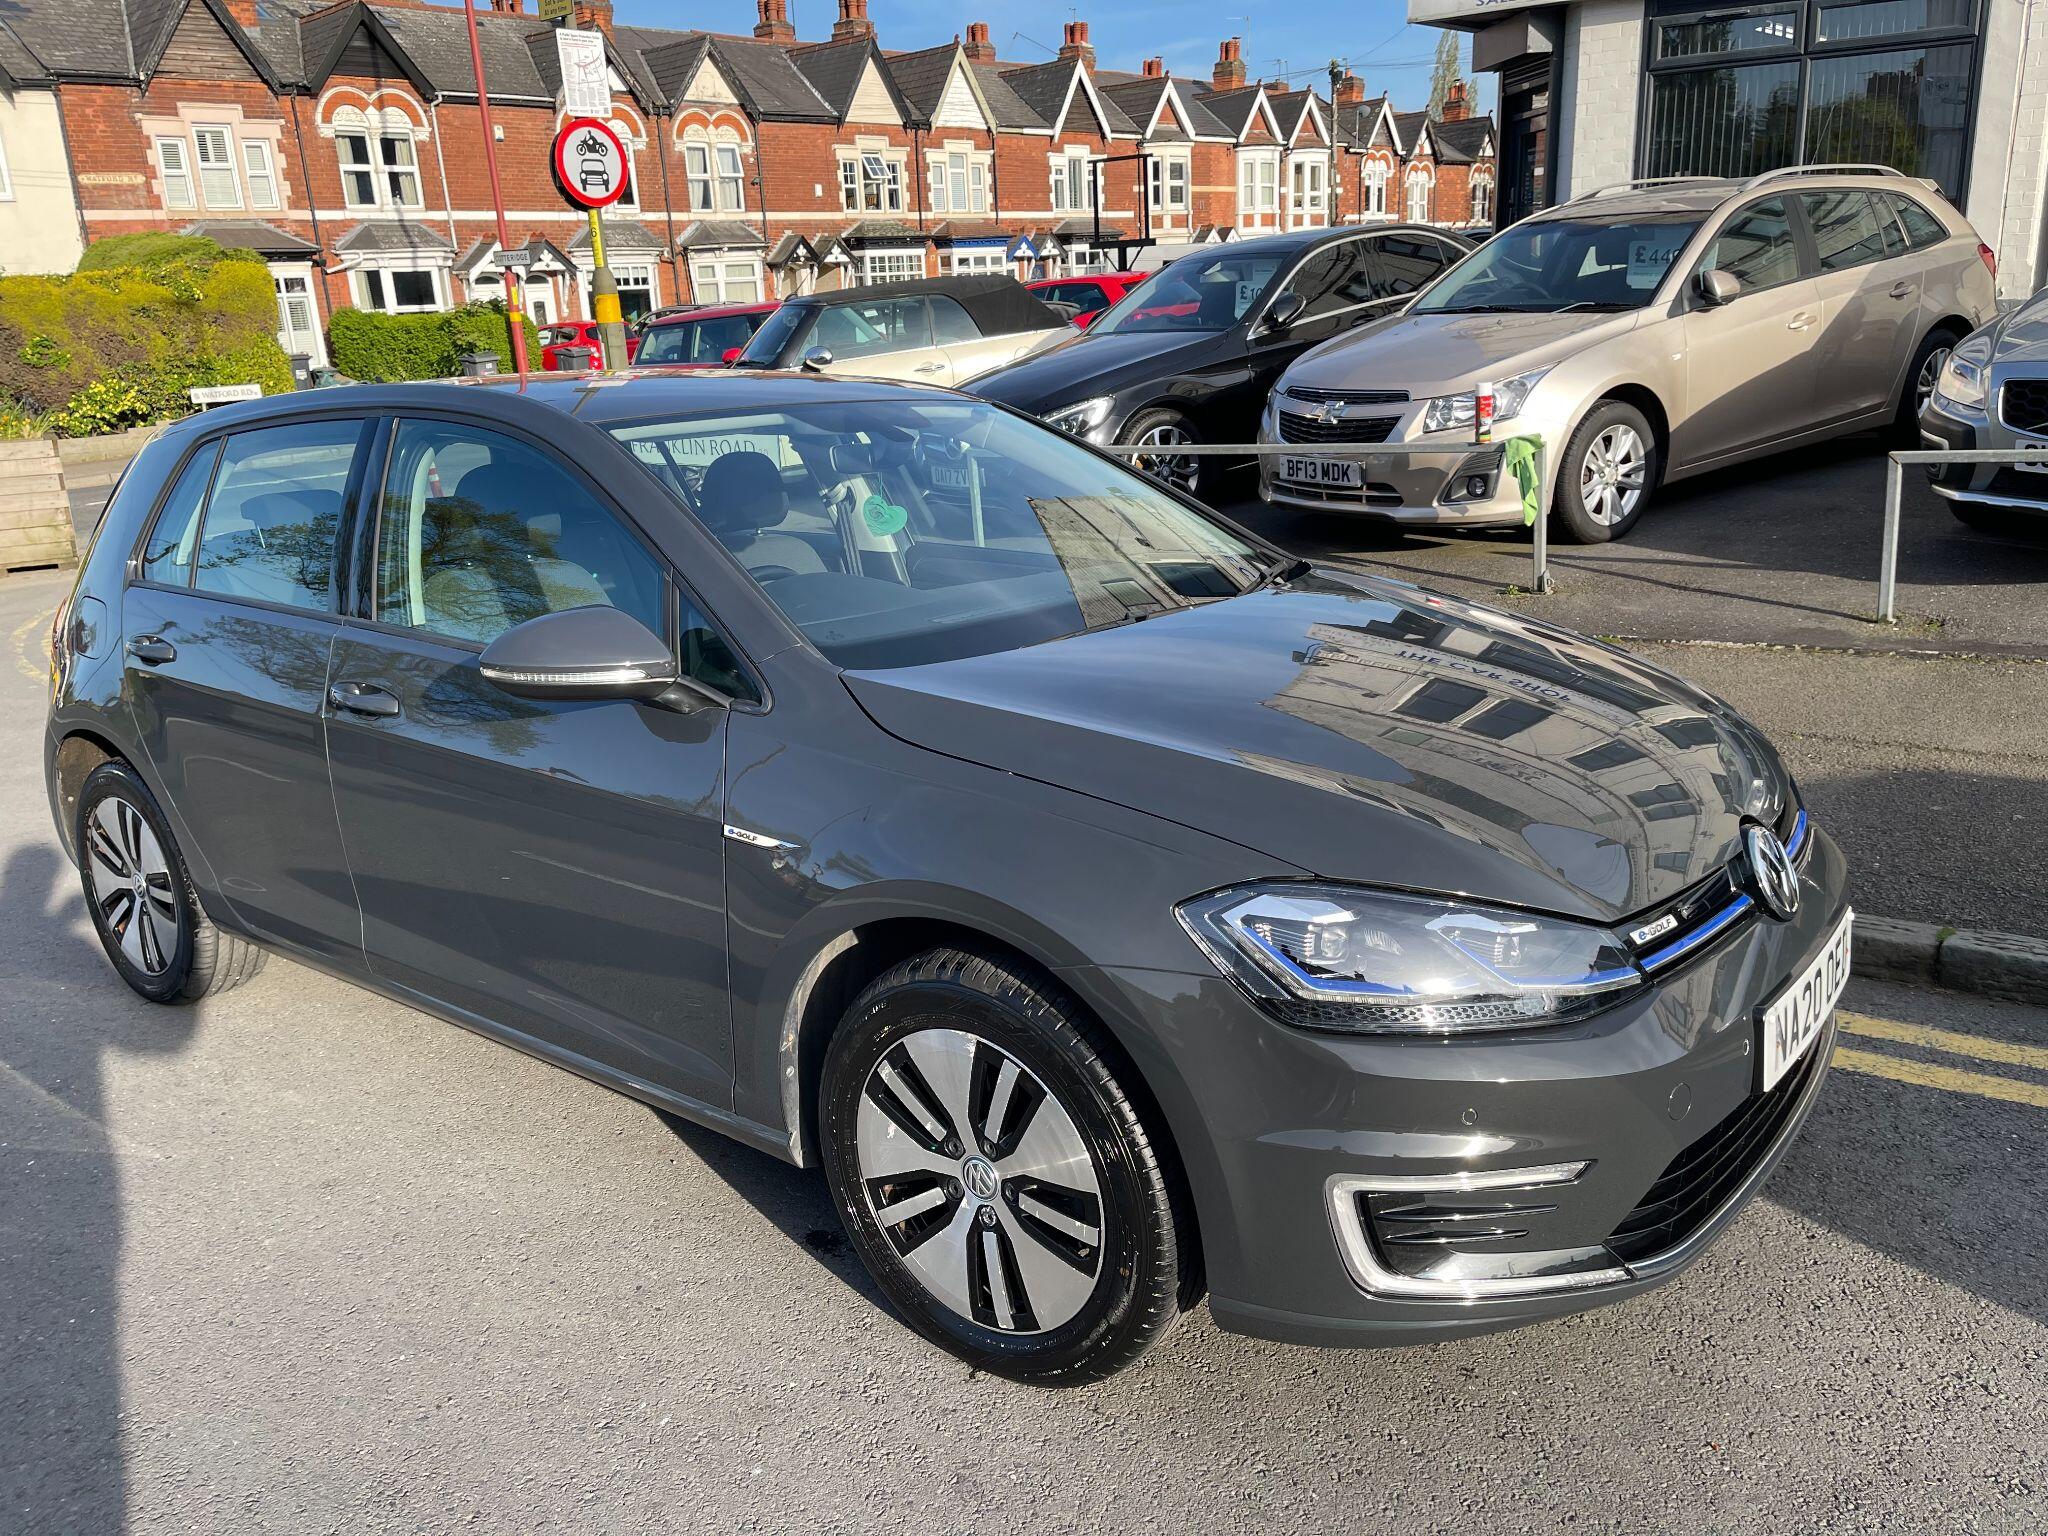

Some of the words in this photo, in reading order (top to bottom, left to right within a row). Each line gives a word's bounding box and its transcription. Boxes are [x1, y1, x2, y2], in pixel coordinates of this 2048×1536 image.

[591, 227, 597, 238] 6
[201, 389, 239, 399] WATFORD
[709, 439, 756, 456] ROAD
[1287, 459, 1317, 480] BF13
[1321, 461, 1351, 483] MDK
[728, 828, 758, 842] e-GOLF
[1638, 918, 1671, 940] e-GOLF
[1775, 967, 1823, 1063] NA20
